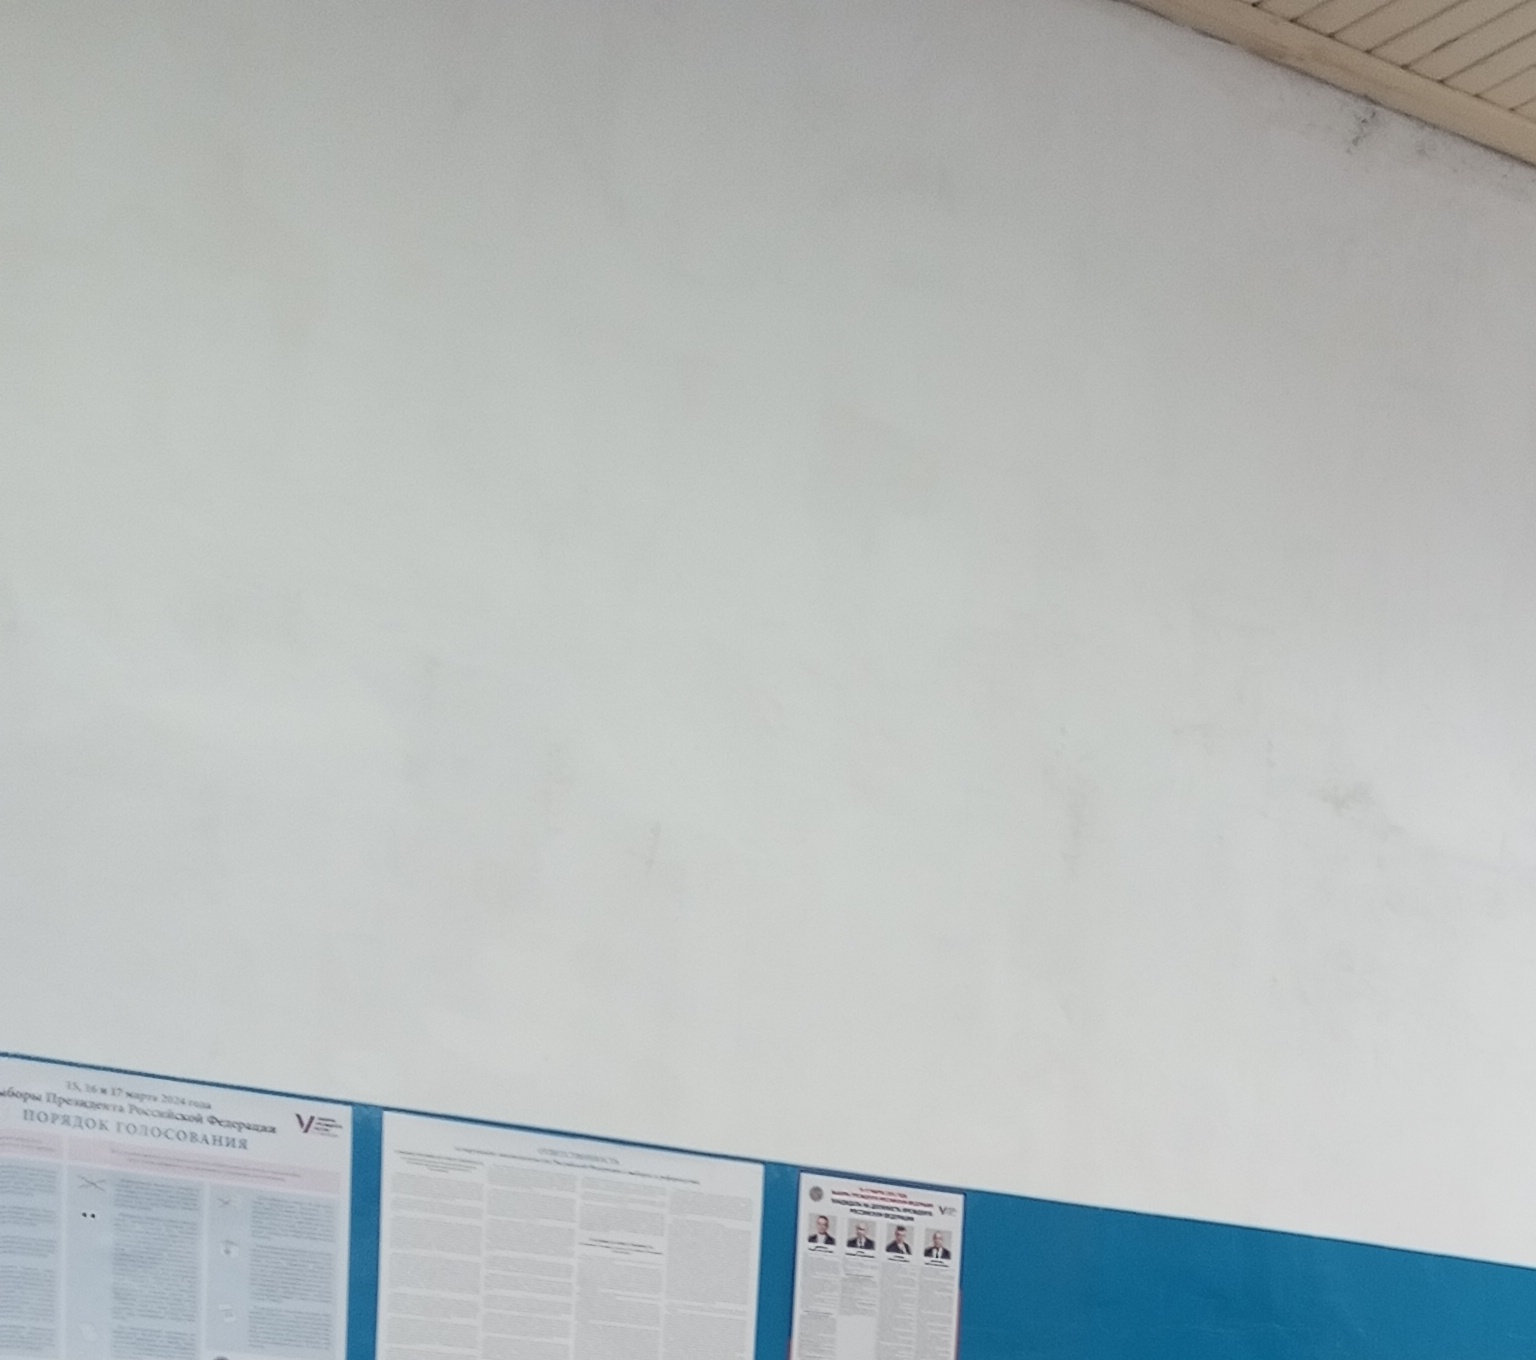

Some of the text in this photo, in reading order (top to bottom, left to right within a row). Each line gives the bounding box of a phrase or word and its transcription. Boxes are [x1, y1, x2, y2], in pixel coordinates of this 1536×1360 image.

[0, 1086, 41, 1103] ыборы
[23, 1108, 249, 1151] ПОРЯДОК ГОЛОСОВАНИЯ
